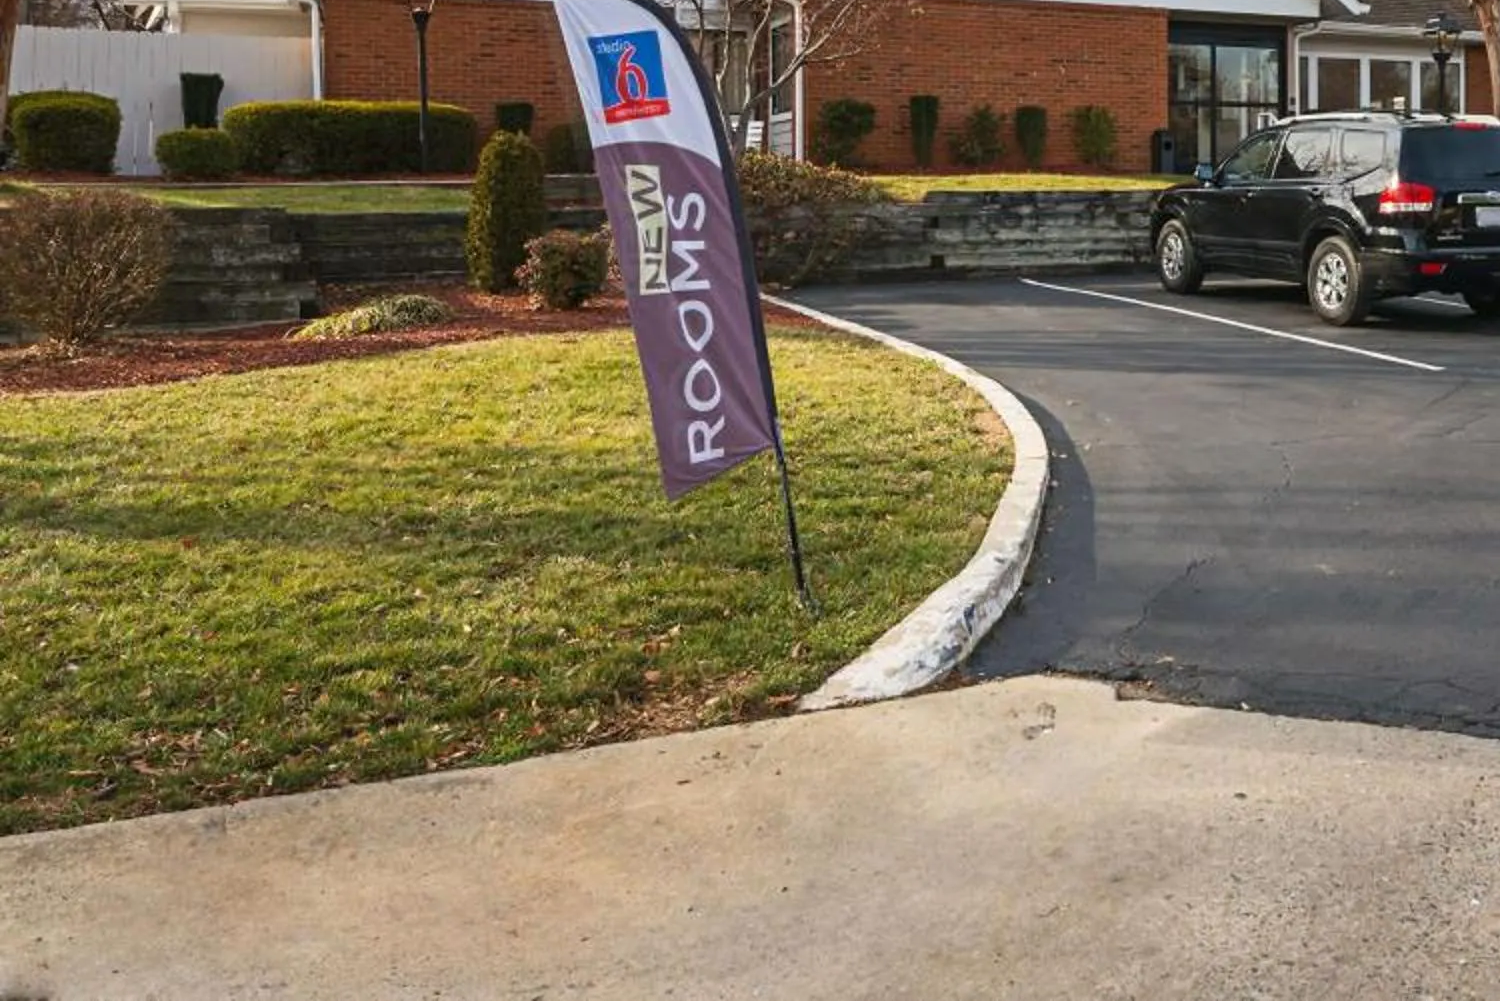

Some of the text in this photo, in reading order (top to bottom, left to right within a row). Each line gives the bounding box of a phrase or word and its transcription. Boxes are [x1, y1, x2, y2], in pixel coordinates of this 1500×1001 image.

[615, 44, 649, 104] 6
[631, 170, 665, 290] NEW
[667, 192, 725, 464] ROOMS
